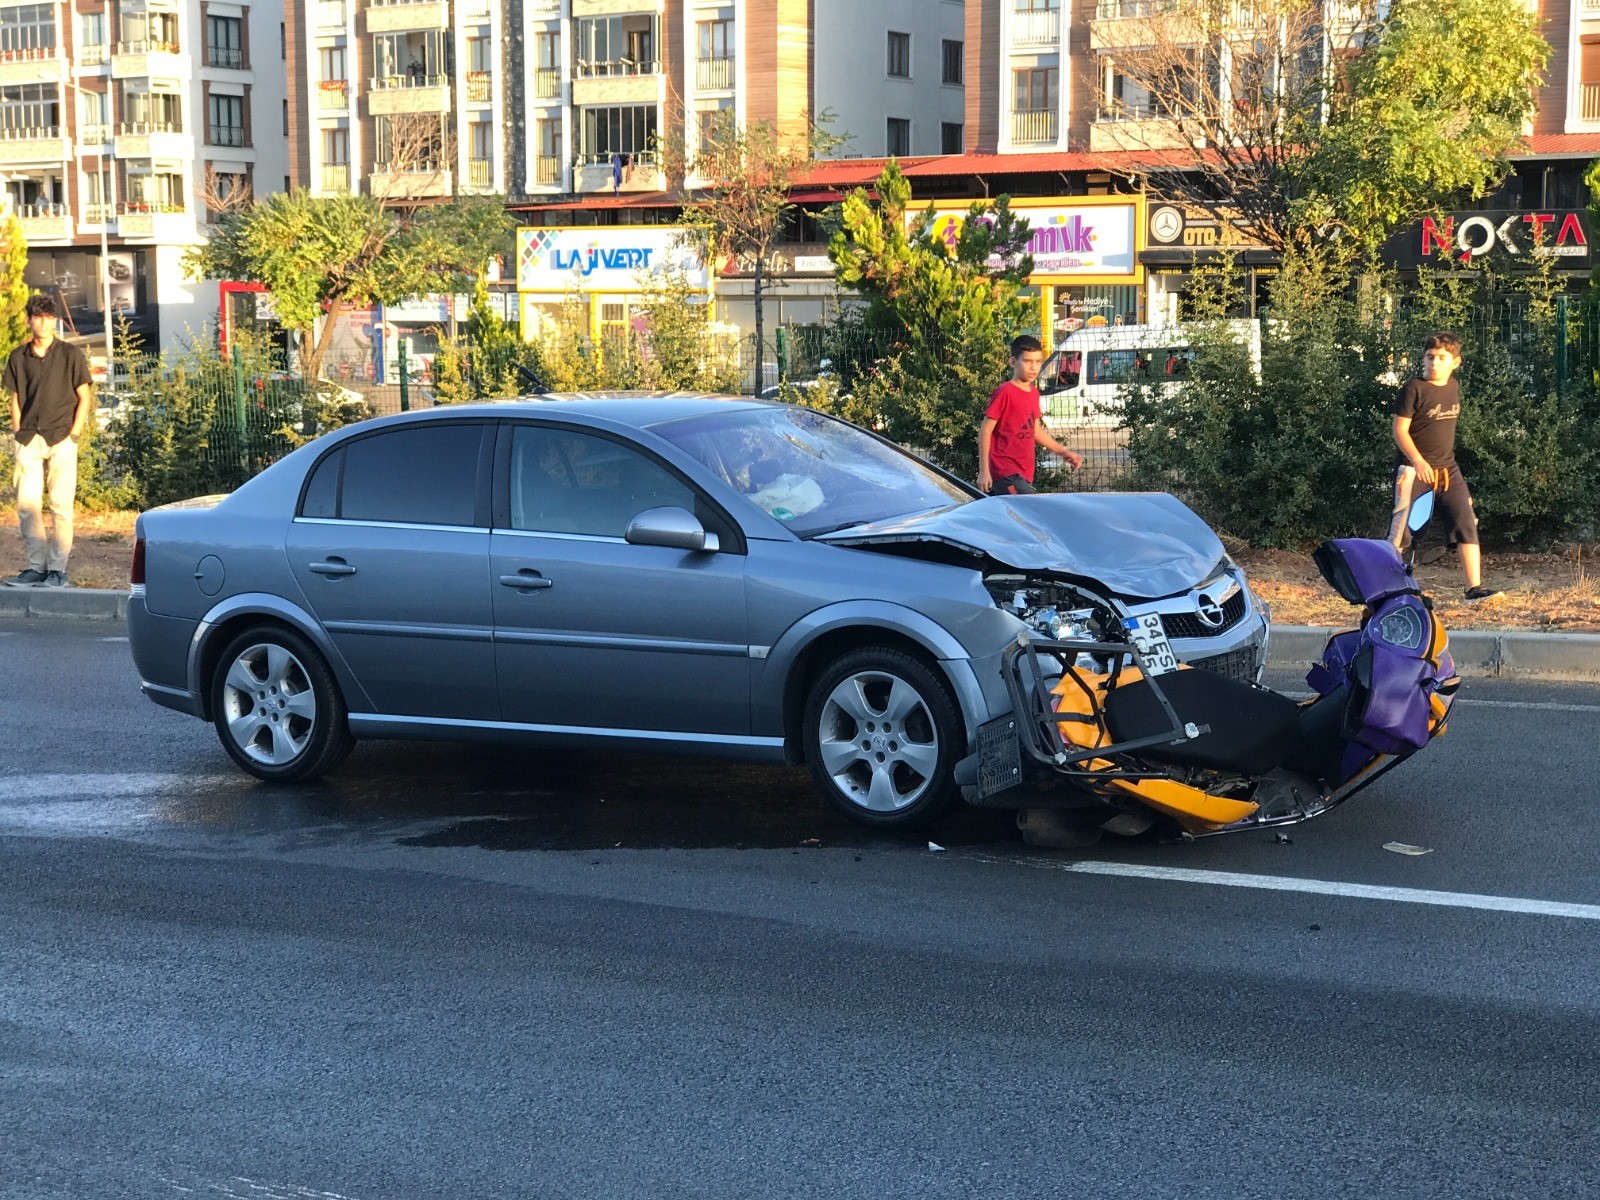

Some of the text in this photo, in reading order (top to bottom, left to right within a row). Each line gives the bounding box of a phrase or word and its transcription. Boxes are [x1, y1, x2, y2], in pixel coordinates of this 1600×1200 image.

[1183, 227, 1216, 246] OTO
[1421, 213, 1588, 258] NOKTA
[1144, 617, 1163, 639] 34
